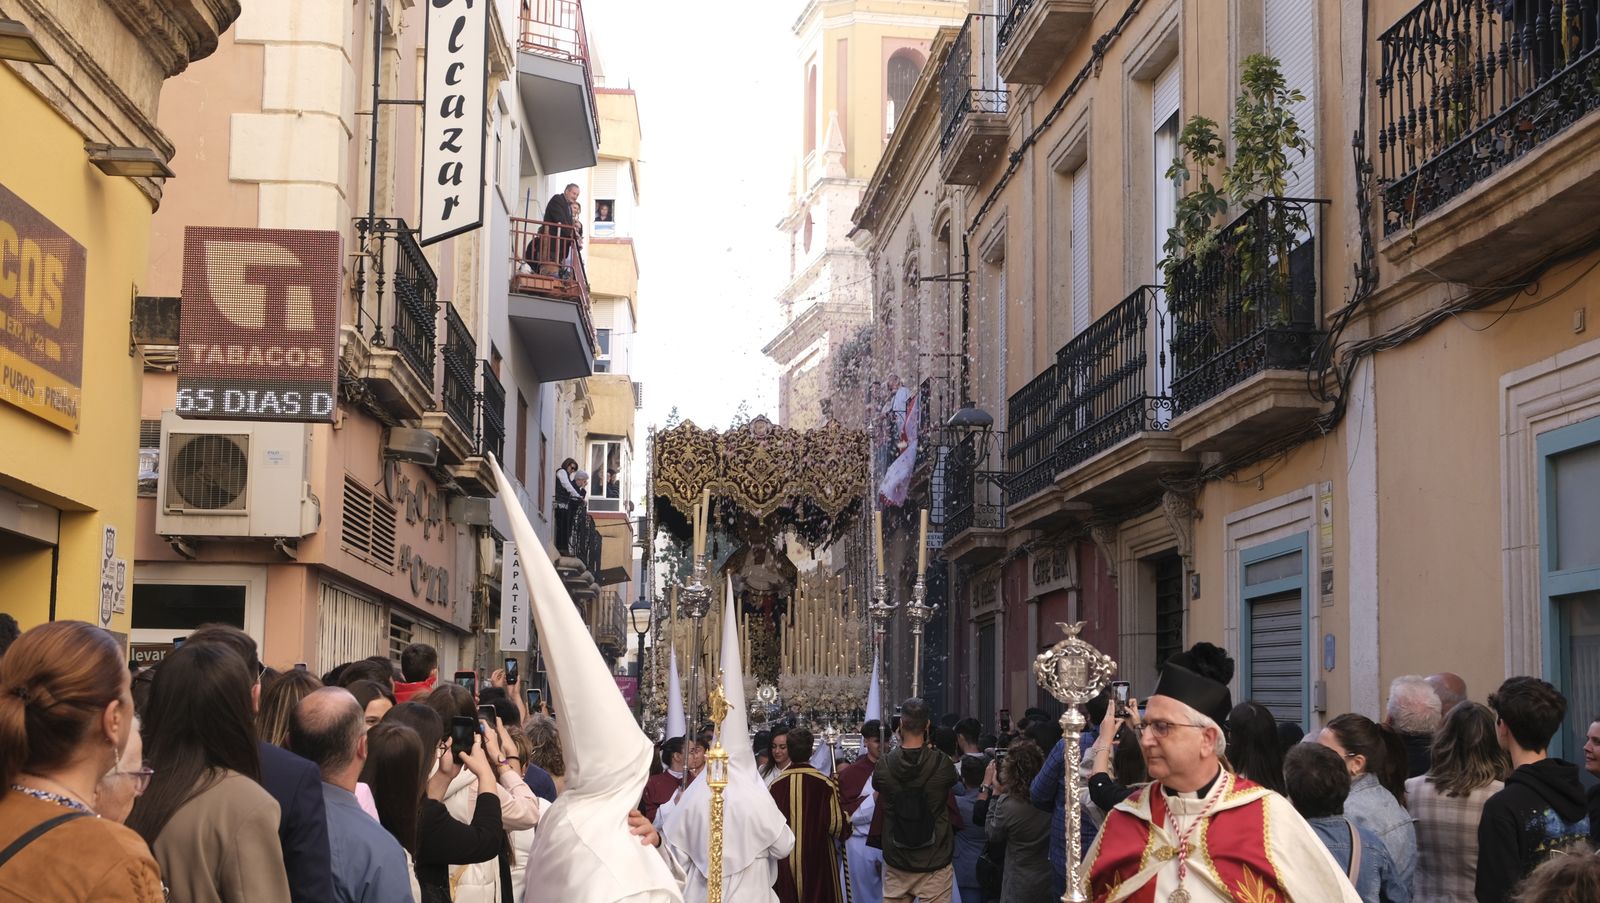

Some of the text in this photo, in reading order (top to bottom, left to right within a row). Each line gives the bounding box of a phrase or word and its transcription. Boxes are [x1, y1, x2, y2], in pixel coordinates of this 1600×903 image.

[432, 0, 474, 221] lcazar
[188, 344, 325, 367] TABACOS
[3, 366, 35, 399] PUROS
[223, 390, 301, 414] DIAS
